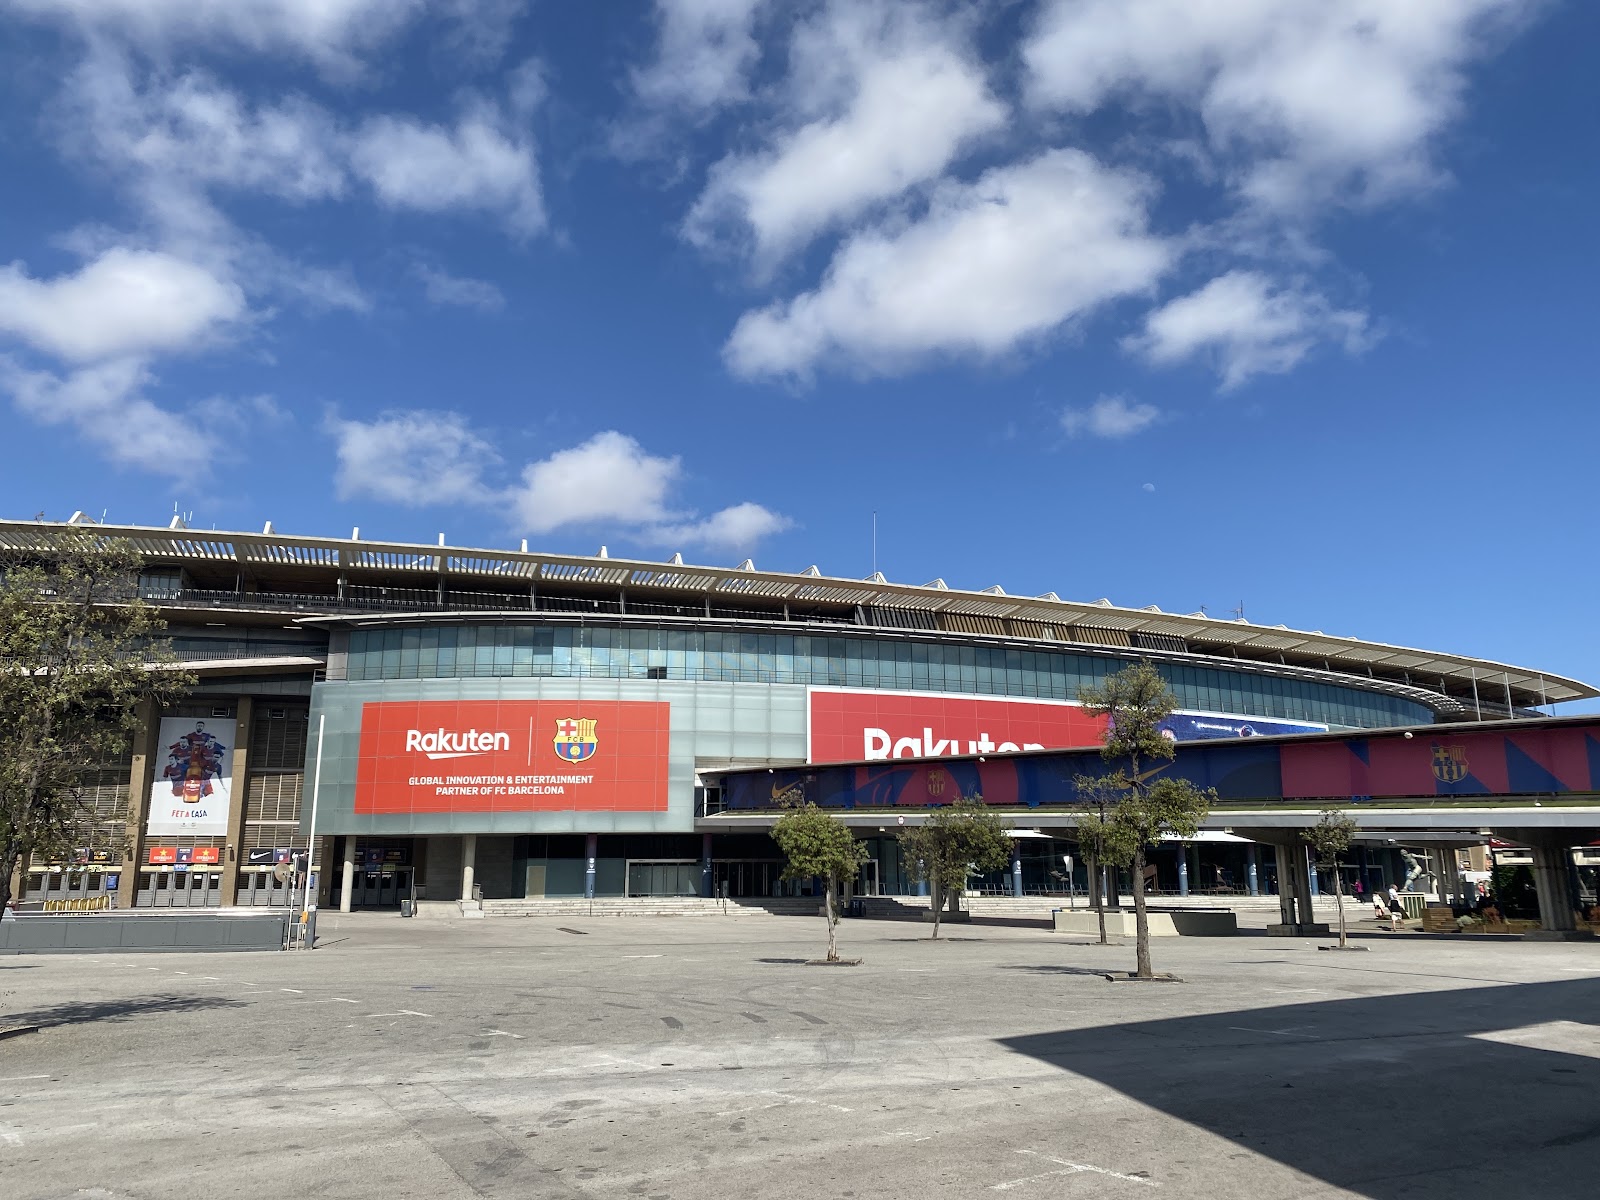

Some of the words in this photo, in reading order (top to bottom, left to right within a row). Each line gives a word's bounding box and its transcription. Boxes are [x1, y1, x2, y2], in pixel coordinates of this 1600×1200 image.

[405, 728, 510, 752] Rakuten
[863, 727, 1047, 761] Rakut
[408, 776, 445, 786] GLOBAL
[445, 775, 505, 785] INNOVATION
[505, 775, 513, 785] &
[514, 775, 594, 784] ENTERTAINMENT
[435, 786, 479, 796] PARTNER
[480, 786, 493, 795] OF
[494, 786, 507, 795] FC
[507, 785, 565, 795] BARCELONA
[191, 809, 208, 818] CASA
